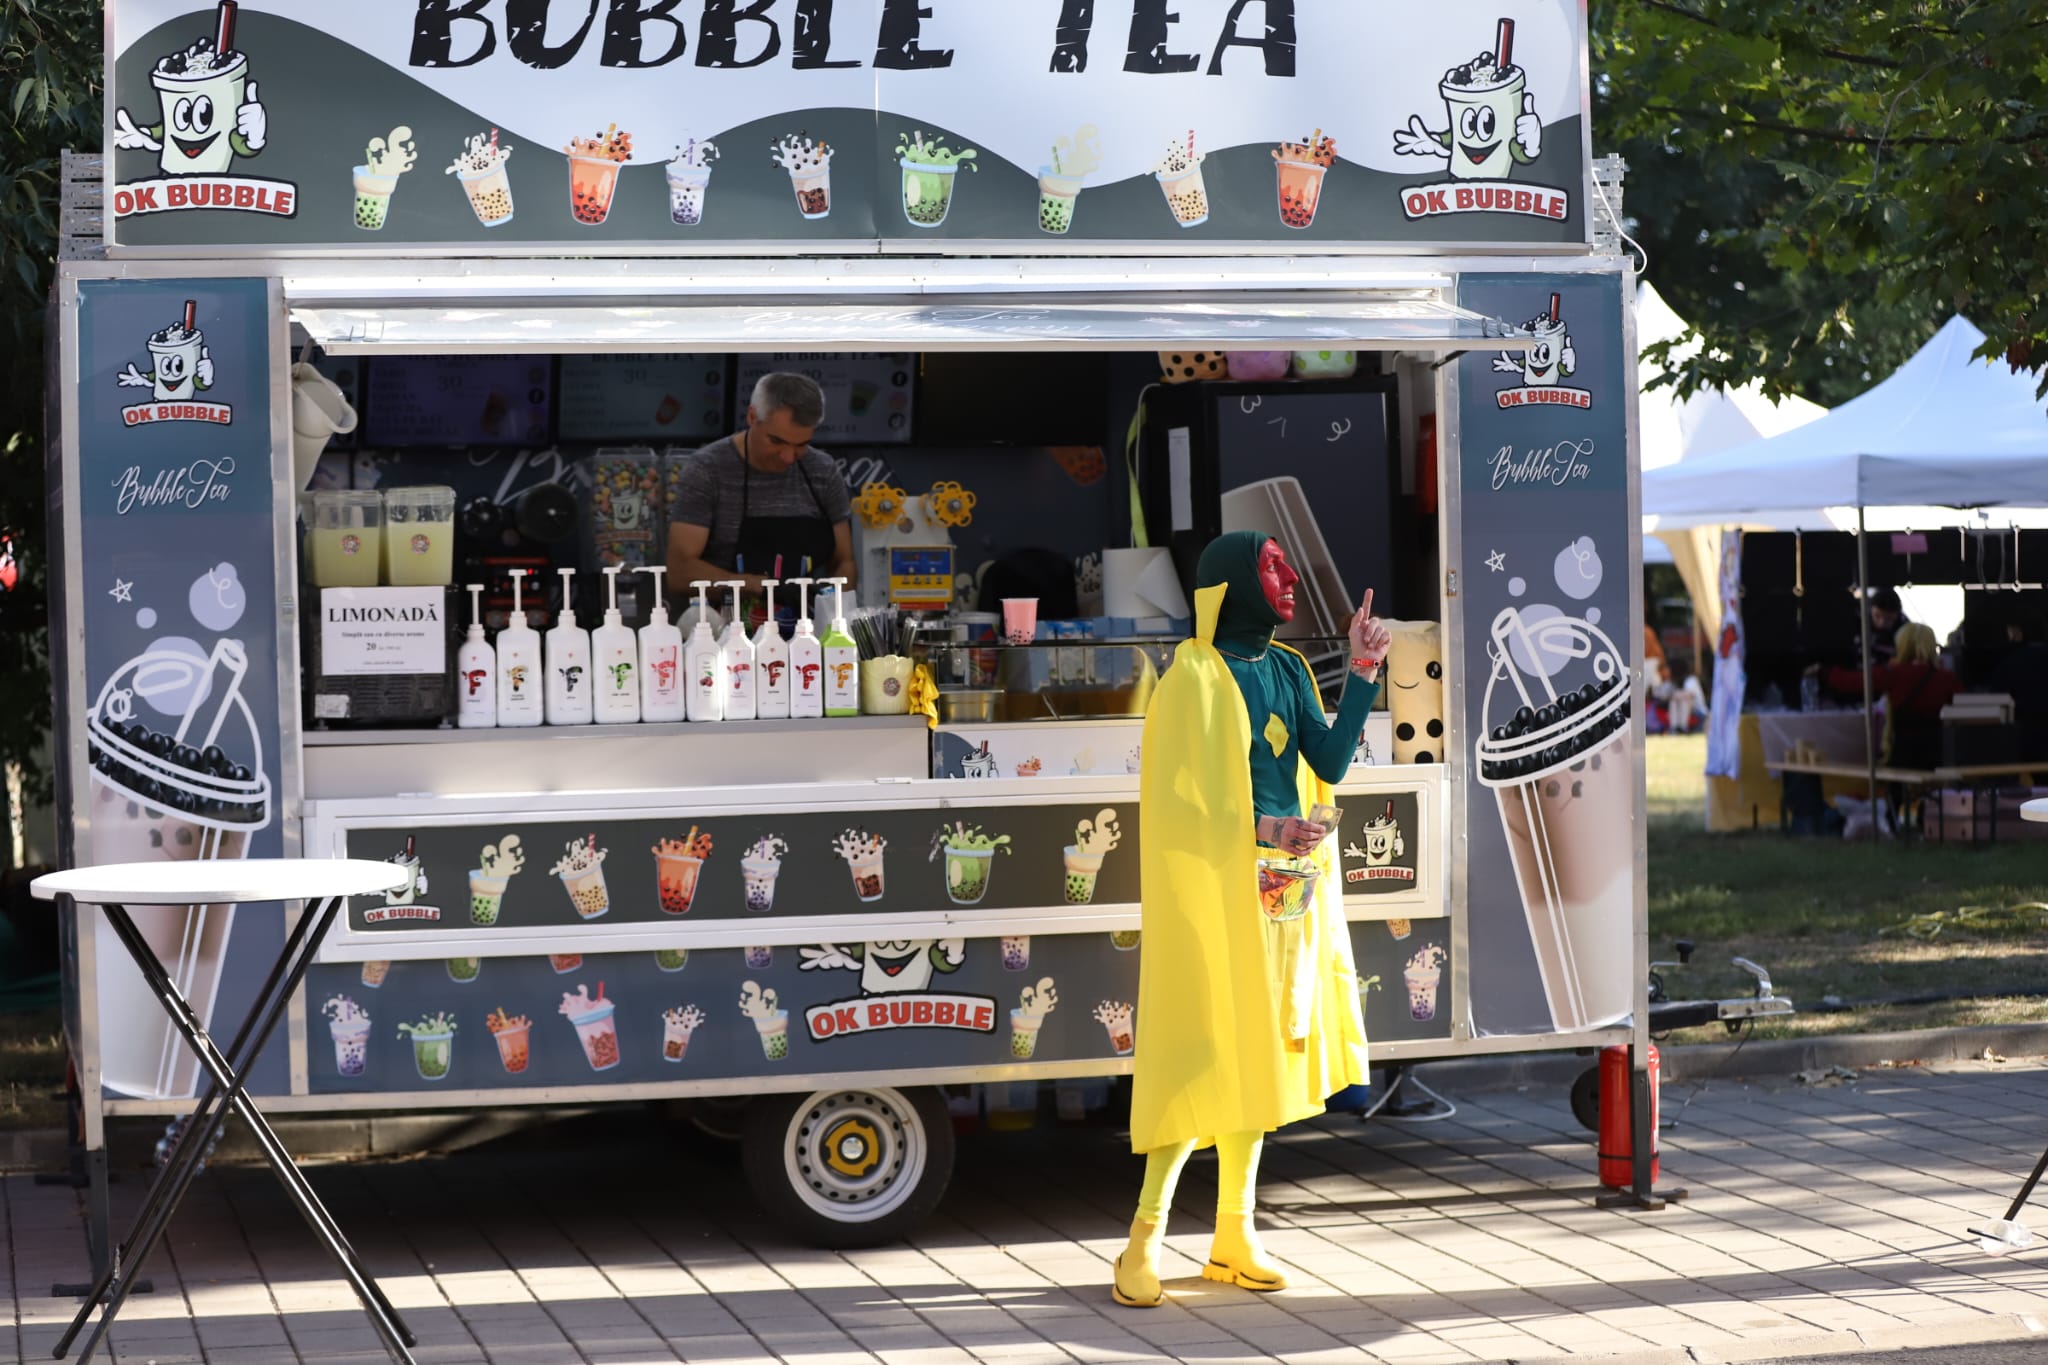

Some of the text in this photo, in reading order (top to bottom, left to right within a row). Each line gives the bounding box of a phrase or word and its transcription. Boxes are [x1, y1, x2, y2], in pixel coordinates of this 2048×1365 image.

[409, 0, 954, 70] BUBBLE
[115, 183, 293, 214] OK BUBBLE
[1406, 188, 1566, 219] OK BUBBLE
[1499, 390, 1590, 408] OK BUBBLE
[125, 405, 230, 424] OK BUBBLE
[1487, 438, 1595, 491] Bubble Tea
[112, 456, 236, 515] Bubble Tea
[328, 603, 438, 622] LIMONADĂ
[366, 642, 377, 651] 20
[1348, 869, 1413, 882] OK BUBBLE
[367, 908, 439, 922] OK BUBBLE
[812, 1001, 993, 1037] OK BUBBLE
